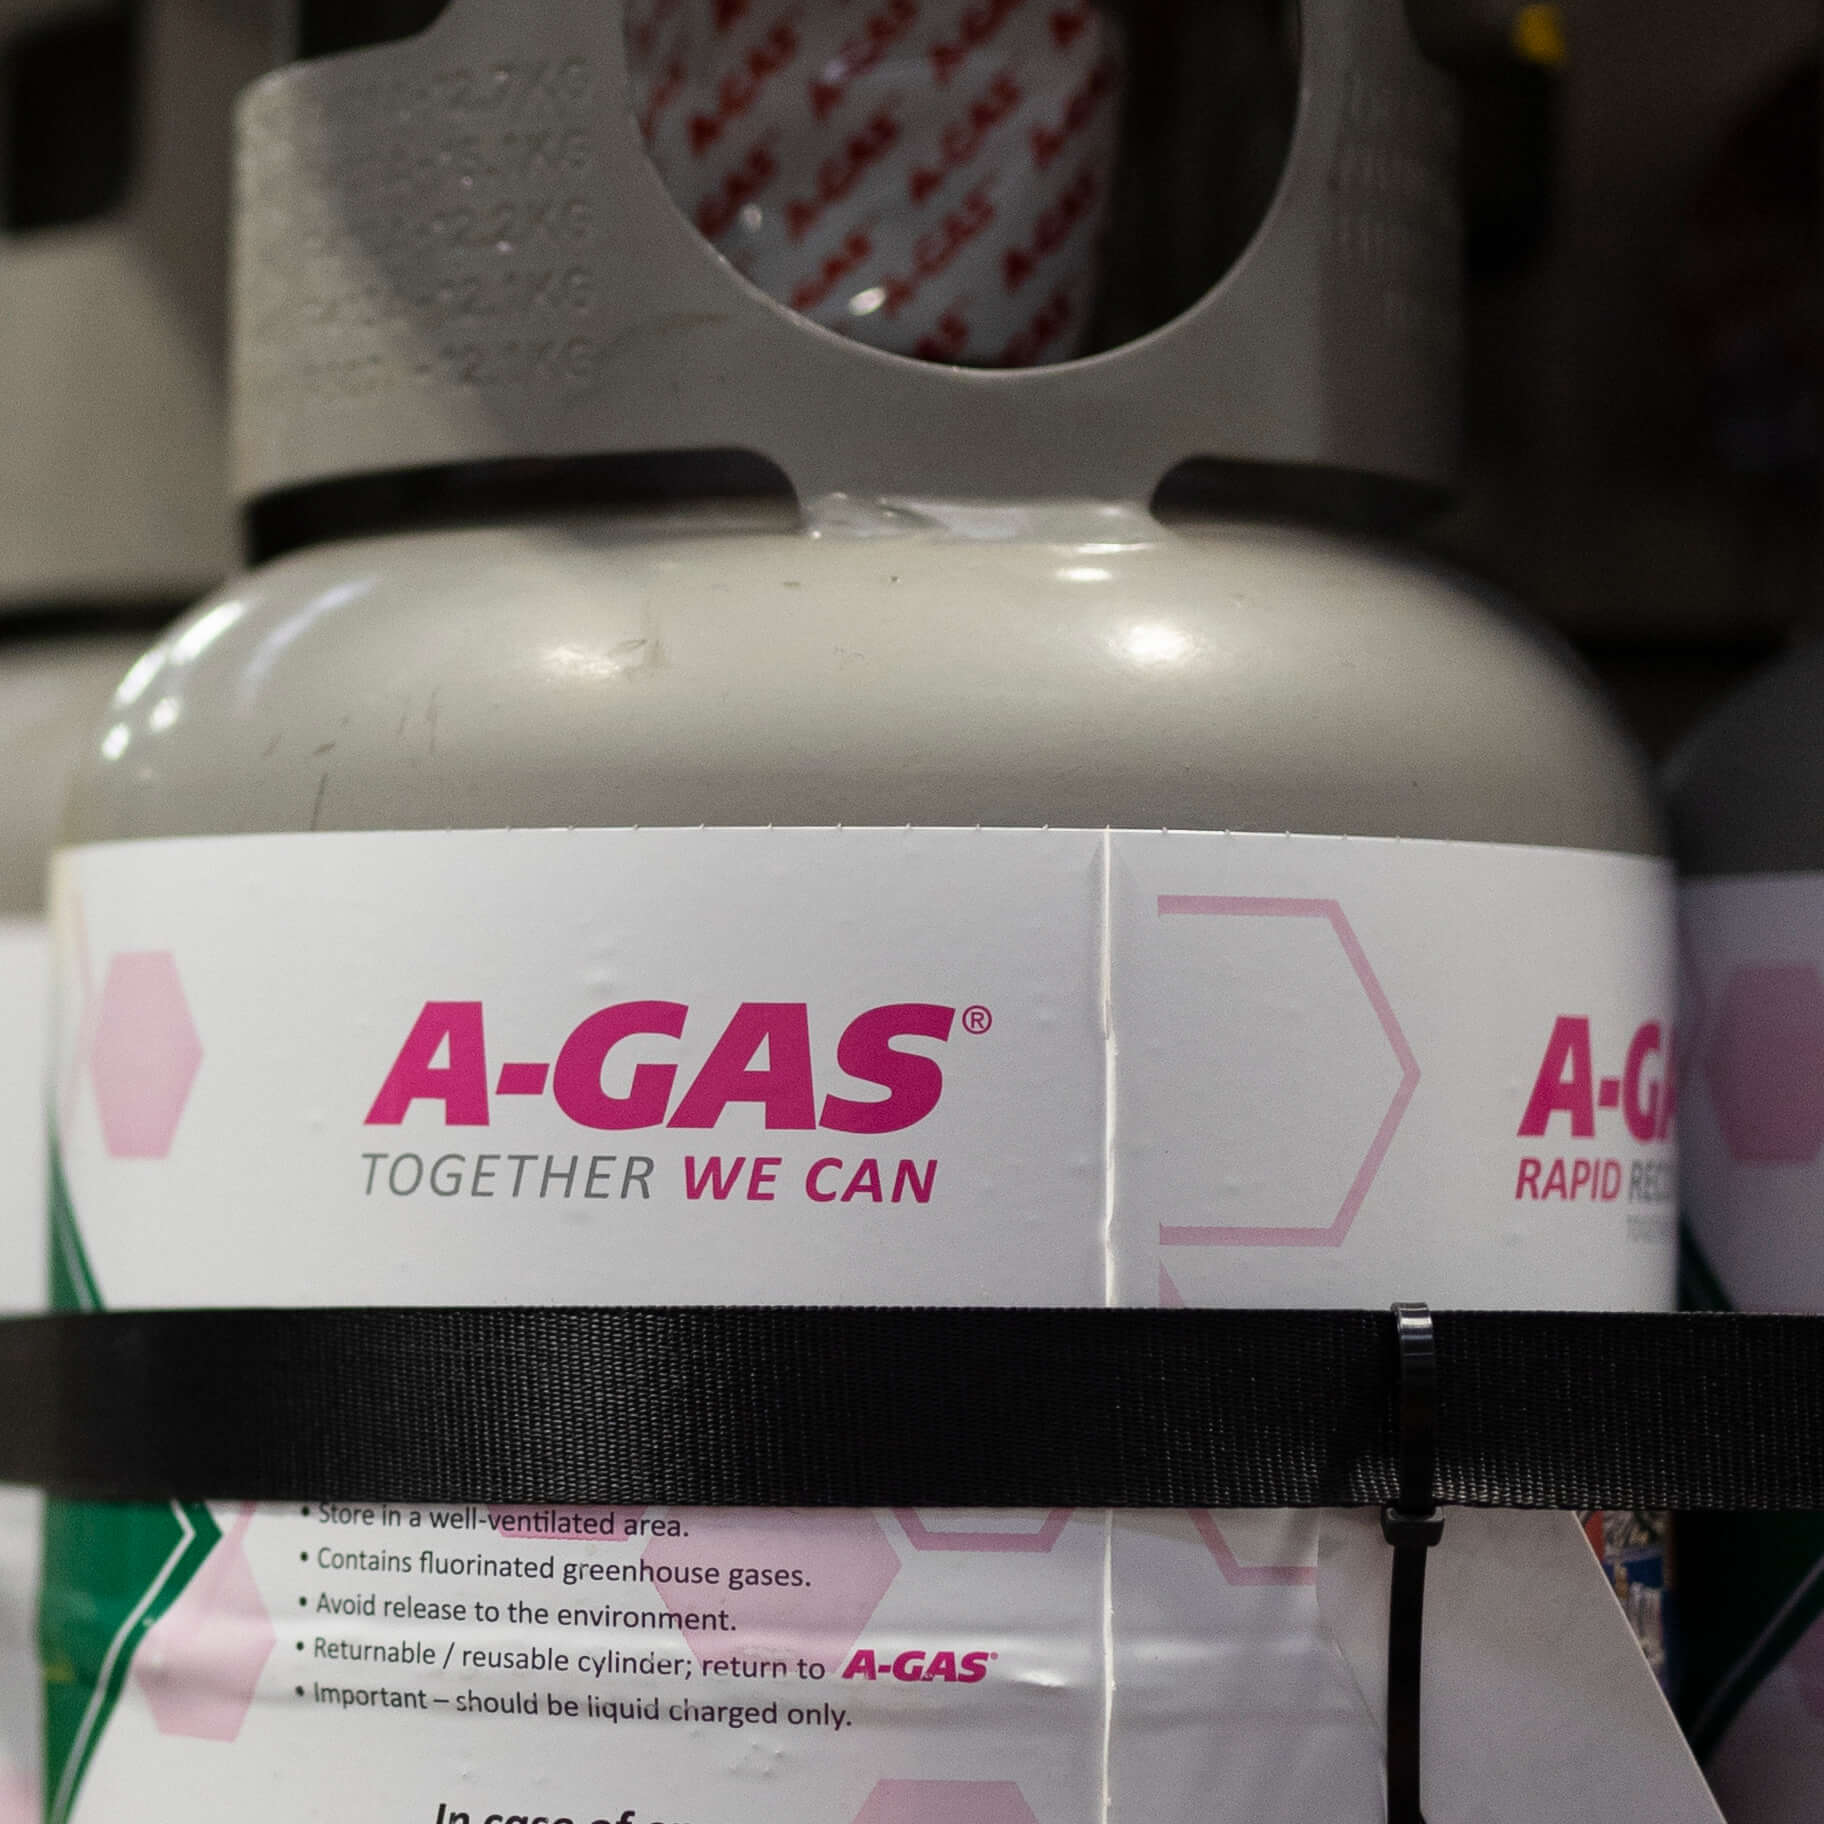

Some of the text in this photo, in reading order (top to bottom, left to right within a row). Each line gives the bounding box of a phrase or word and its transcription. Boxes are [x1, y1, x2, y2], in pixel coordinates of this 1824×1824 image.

[362, 1153, 937, 1203] TOGETHER WE CAN
[1515, 1158, 1621, 1200] RAPID
[318, 1504, 690, 1538] Store in a well-ventilated area.
[318, 1547, 811, 1590] Contains fluorinated greenhouse gases.
[316, 1593, 736, 1631] Avoid release to the environment.
[315, 1637, 436, 1665] Returnable
[443, 1642, 455, 1669] /
[463, 1647, 569, 1671] reusable
[578, 1650, 691, 1680] cylinder;
[703, 1657, 787, 1678] return
[797, 1659, 825, 1680] to
[314, 1683, 428, 1709] Important
[456, 1689, 538, 1714] should
[548, 1693, 579, 1717] be
[587, 1695, 659, 1724] liquid
[669, 1698, 777, 1728] charged
[788, 1703, 851, 1731] only.
